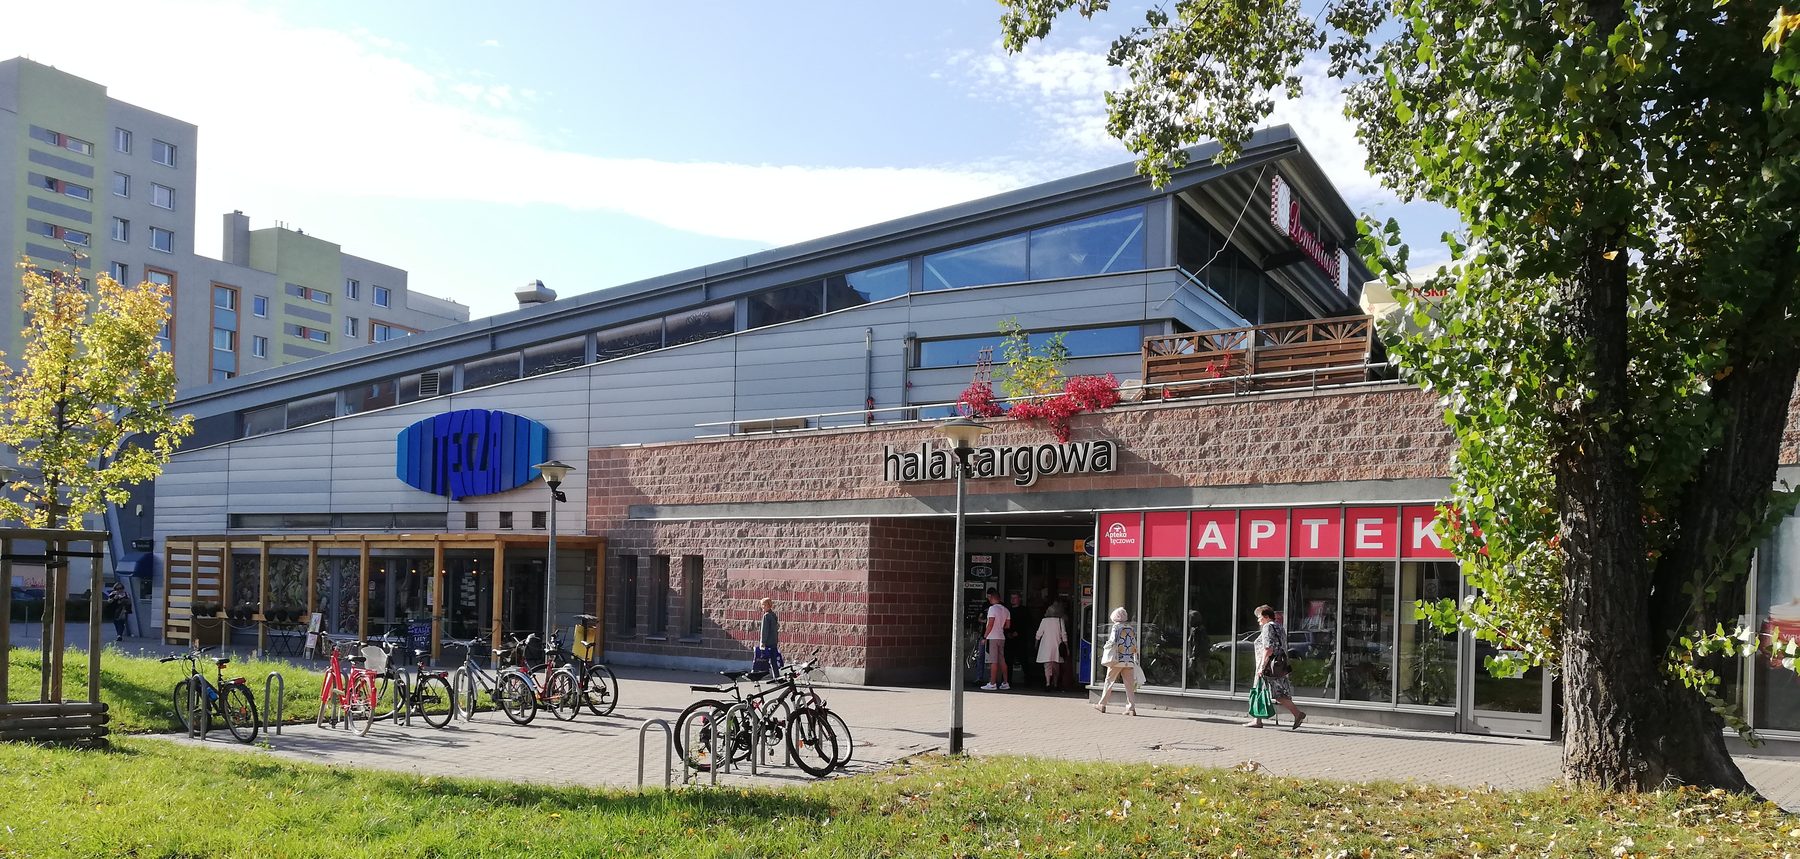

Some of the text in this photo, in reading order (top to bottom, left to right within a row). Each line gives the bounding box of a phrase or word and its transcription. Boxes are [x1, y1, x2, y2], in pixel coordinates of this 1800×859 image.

[884, 442, 951, 481] hala
[1105, 531, 1127, 540] Apteka
[1197, 517, 1488, 550] APTEK
